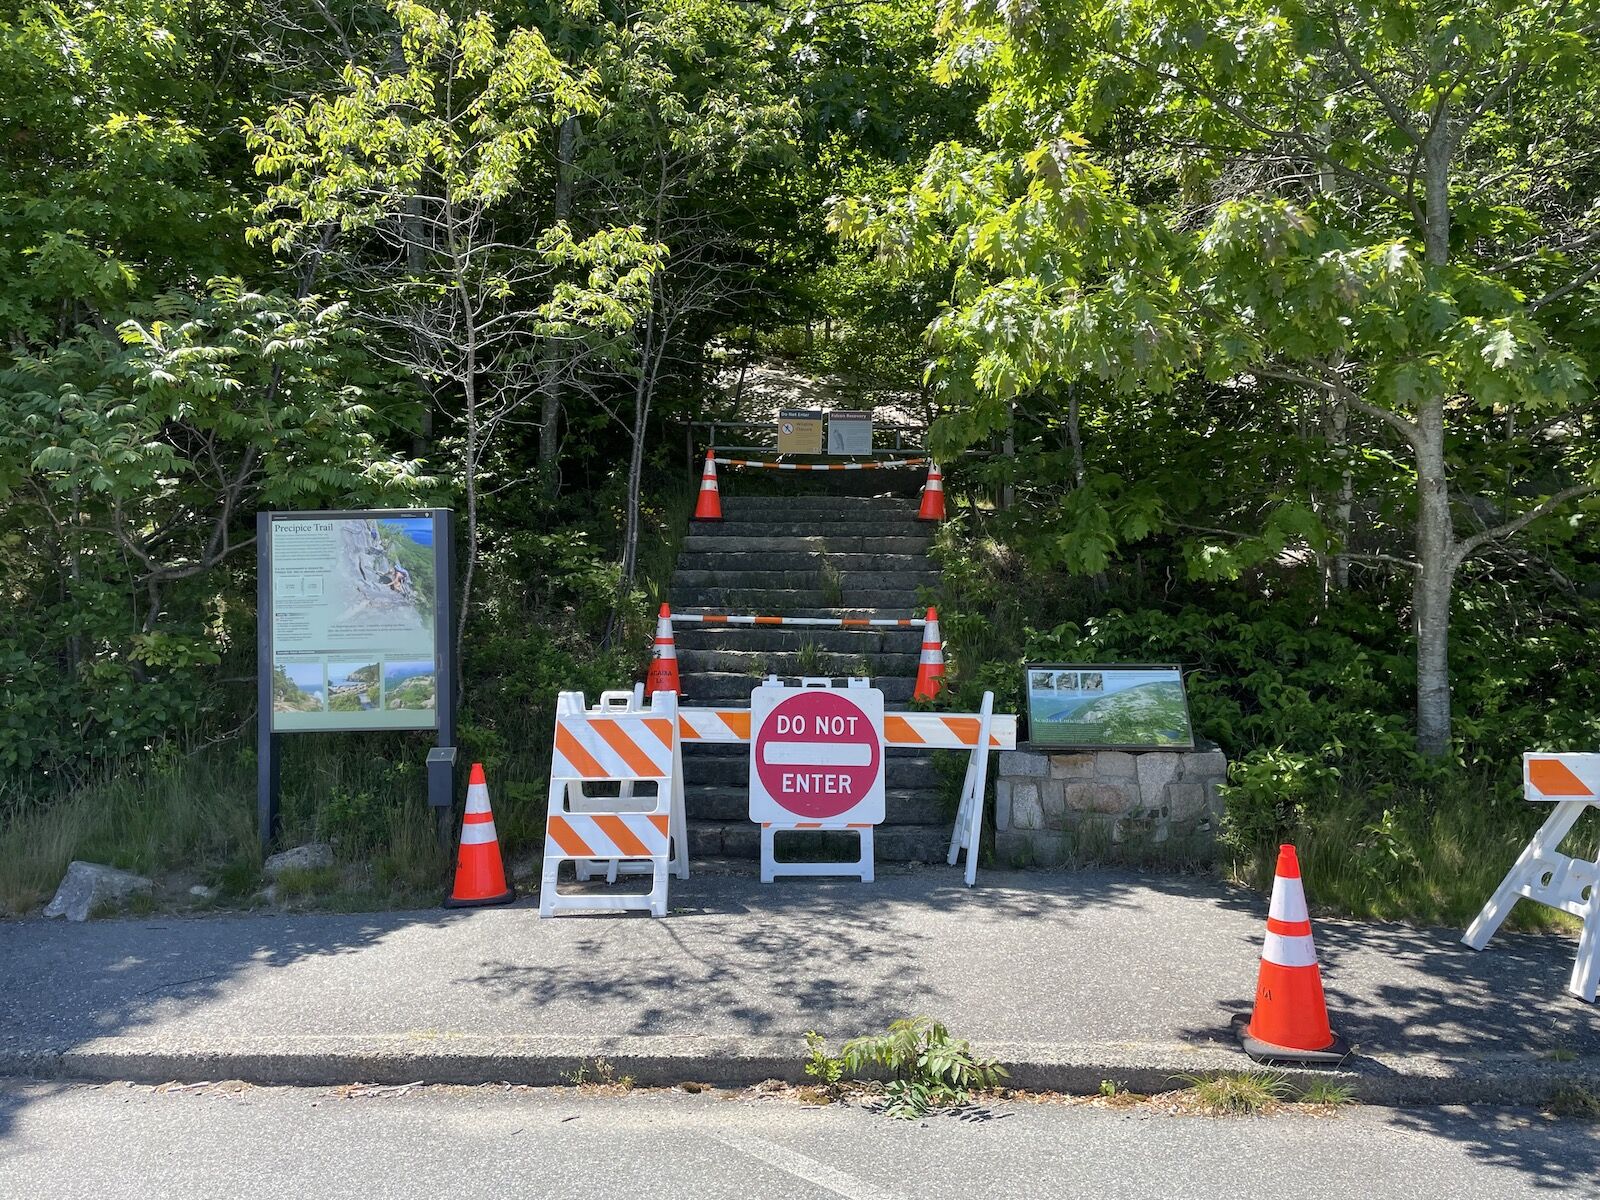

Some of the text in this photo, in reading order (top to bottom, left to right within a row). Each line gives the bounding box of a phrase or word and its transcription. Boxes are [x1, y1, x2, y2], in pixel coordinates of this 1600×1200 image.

[274, 523, 334, 534] Precipice Trail
[776, 714, 859, 737] DO NOT
[781, 772, 852, 794] ENTER
